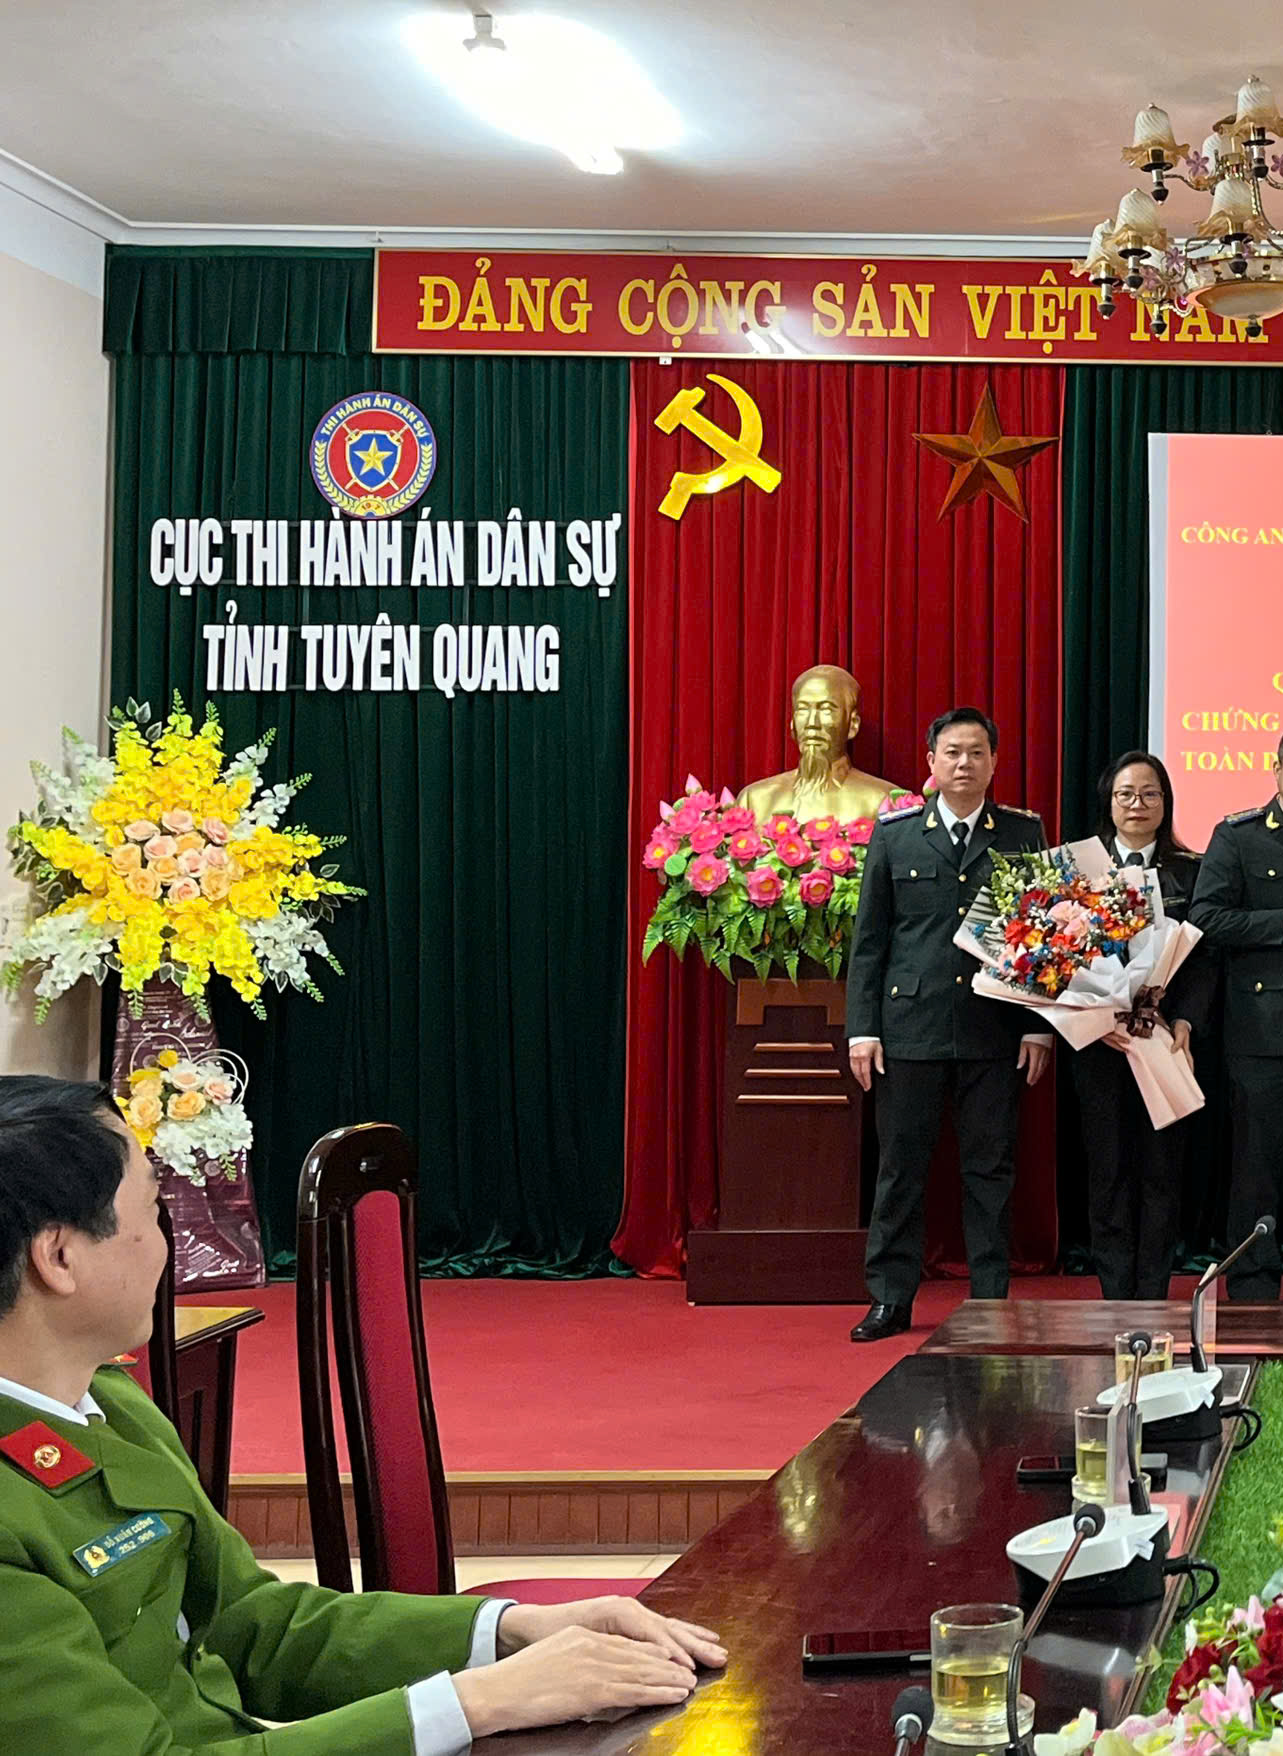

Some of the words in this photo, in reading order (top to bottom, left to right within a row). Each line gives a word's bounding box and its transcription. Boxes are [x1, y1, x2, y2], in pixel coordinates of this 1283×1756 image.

[416, 257, 593, 333] ĐẢNG
[617, 262, 786, 348] CỘNG
[811, 265, 935, 339] SẢN
[963, 270, 1103, 354] VIỆT
[321, 416, 338, 435] THI
[336, 398, 370, 419] HÀNH
[1181, 521, 1249, 544] CÔNG
[151, 518, 223, 596] CỤC
[231, 520, 288, 586] THI
[300, 507, 402, 586] HÀNH
[411, 507, 464, 586] ÁN
[478, 508, 556, 587] DÂN
[567, 513, 621, 597] SỰ
[203, 600, 287, 692] TỈNH
[301, 613, 420, 692] TUYÊN
[433, 625, 560, 699] QUANG
[1182, 706, 1280, 732] CHỨNG
[1180, 746, 1255, 771] TOÀN
